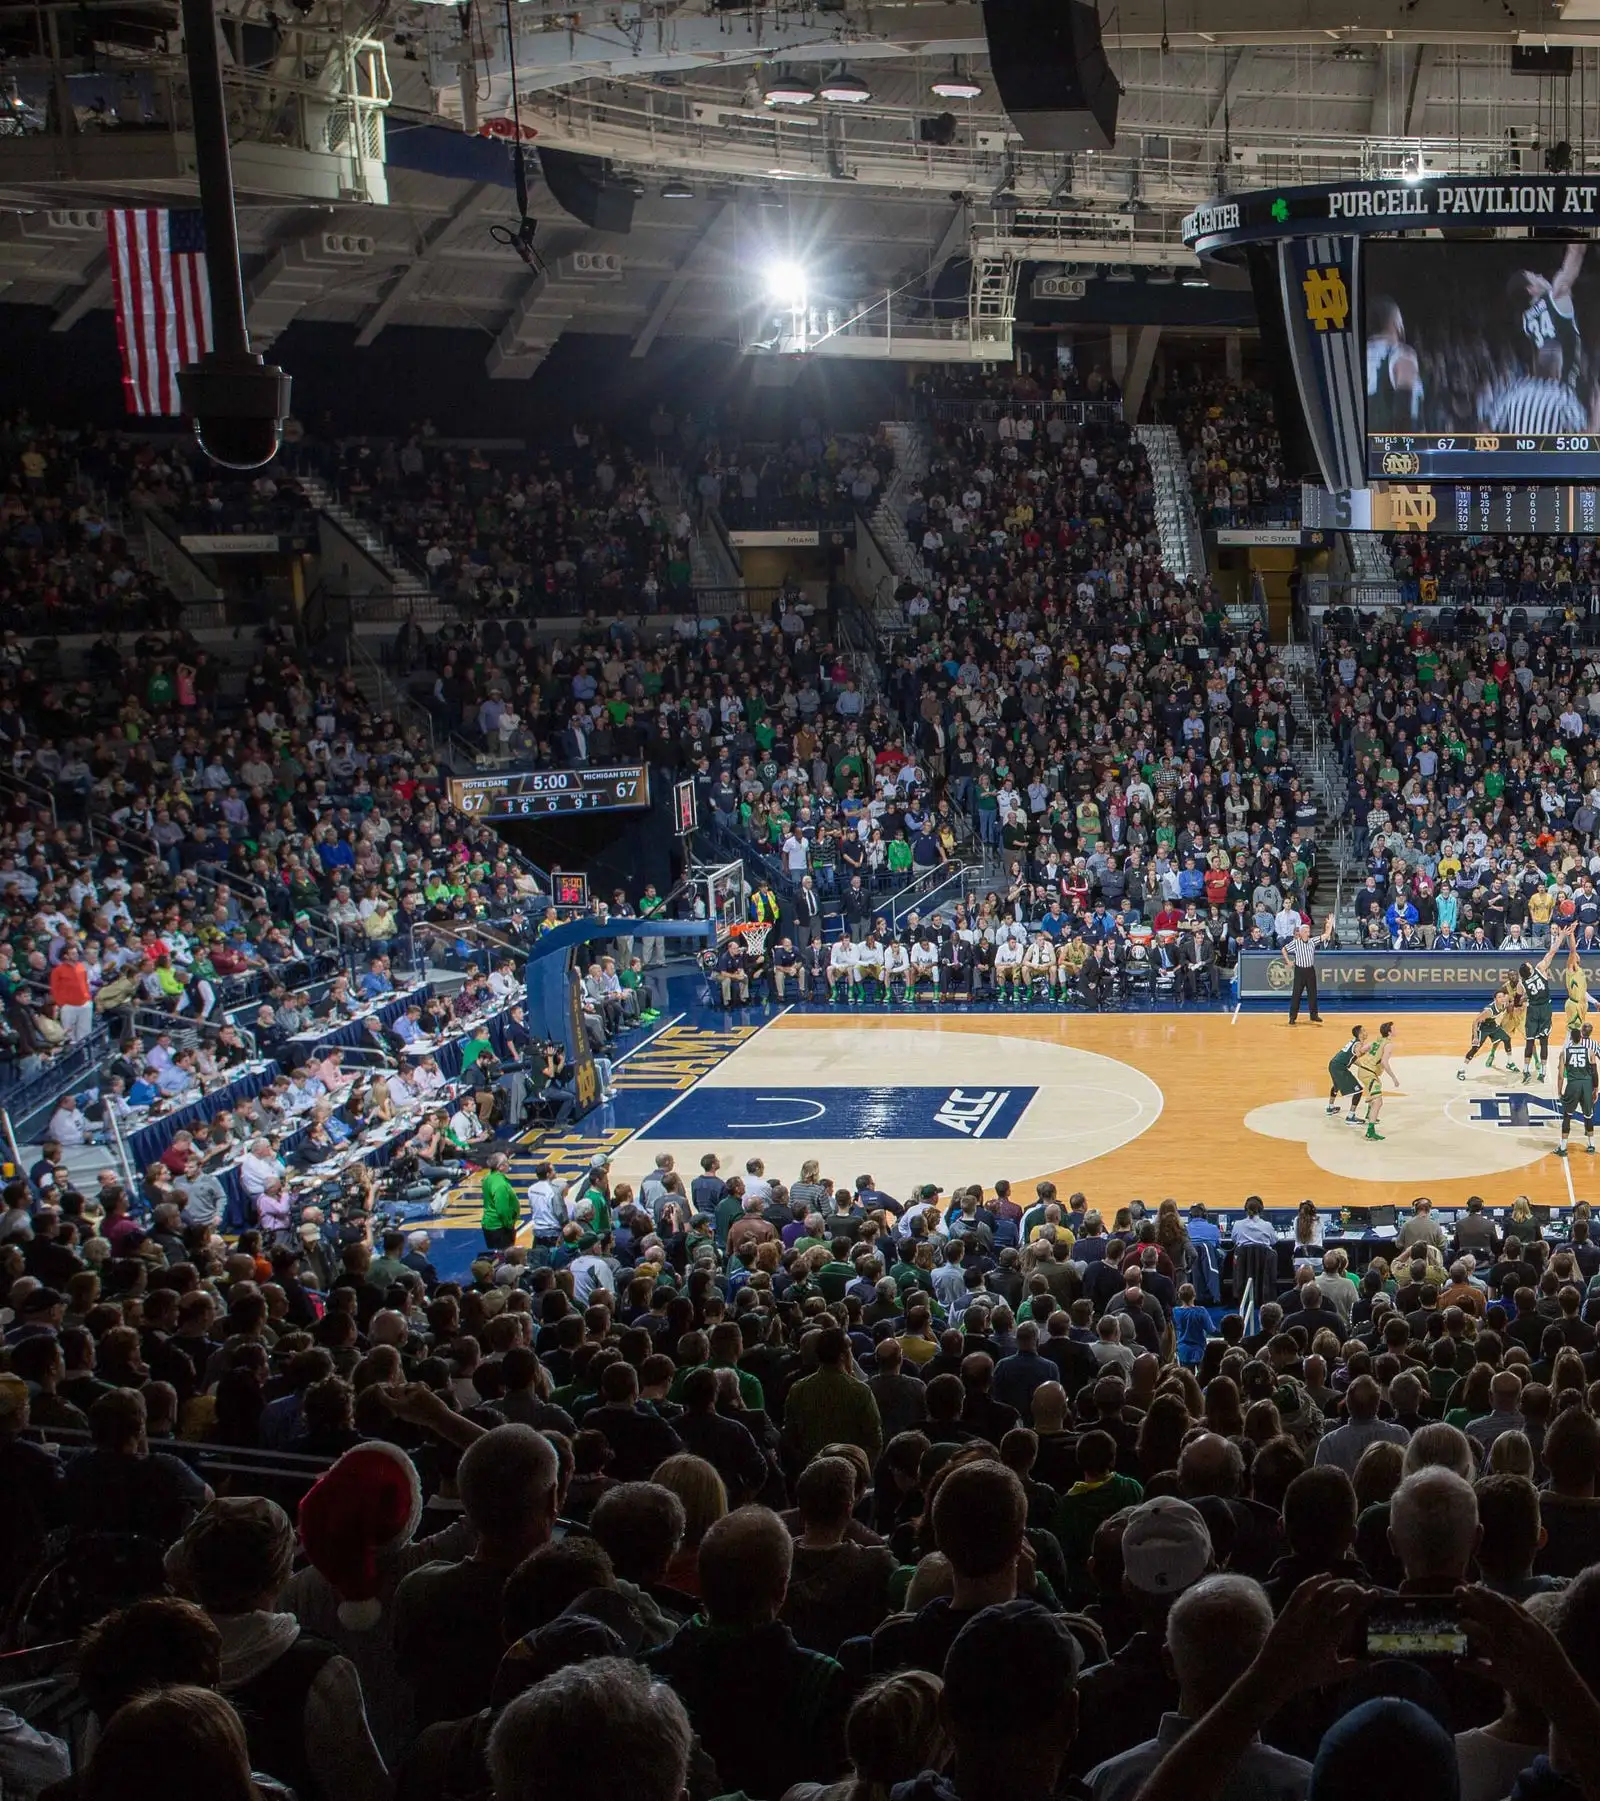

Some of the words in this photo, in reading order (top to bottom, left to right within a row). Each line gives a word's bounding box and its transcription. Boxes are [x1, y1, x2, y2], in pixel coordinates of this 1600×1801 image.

[1328, 188, 1428, 219] PURCELL
[1437, 186, 1555, 214] PAVILION
[1563, 187, 1598, 213] AT
[1199, 203, 1240, 233] CENTER
[1437, 438, 1456, 450] 67
[1516, 439, 1536, 450] ND
[1556, 437, 1589, 451] 5:00
[1458, 500, 1468, 508] 22
[1480, 500, 1490, 508] 25
[1583, 500, 1594, 508] 20
[1458, 508, 1468, 516] 24
[1481, 508, 1490, 516] 10
[1583, 508, 1594, 516] 22
[1458, 516, 1468, 524] 30
[1583, 516, 1594, 524] 34
[1458, 524, 1468, 532] 32
[1480, 524, 1488, 532] 12
[1583, 524, 1594, 532] 45
[583, 771, 619, 780] MICHIGAN
[620, 770, 641, 778] STATE
[462, 780, 486, 789] NOTRE
[488, 779, 509, 788] DAME
[533, 774, 567, 790] 5:00
[616, 781, 637, 798] 67
[462, 794, 484, 811] 67
[521, 802, 529, 813] 6
[575, 798, 582, 809] 9
[1321, 968, 1366, 982] FIVE
[1374, 967, 1508, 983] CONFERENCE
[1528, 979, 1546, 995] 34
[1569, 1053, 1586, 1067] 45
